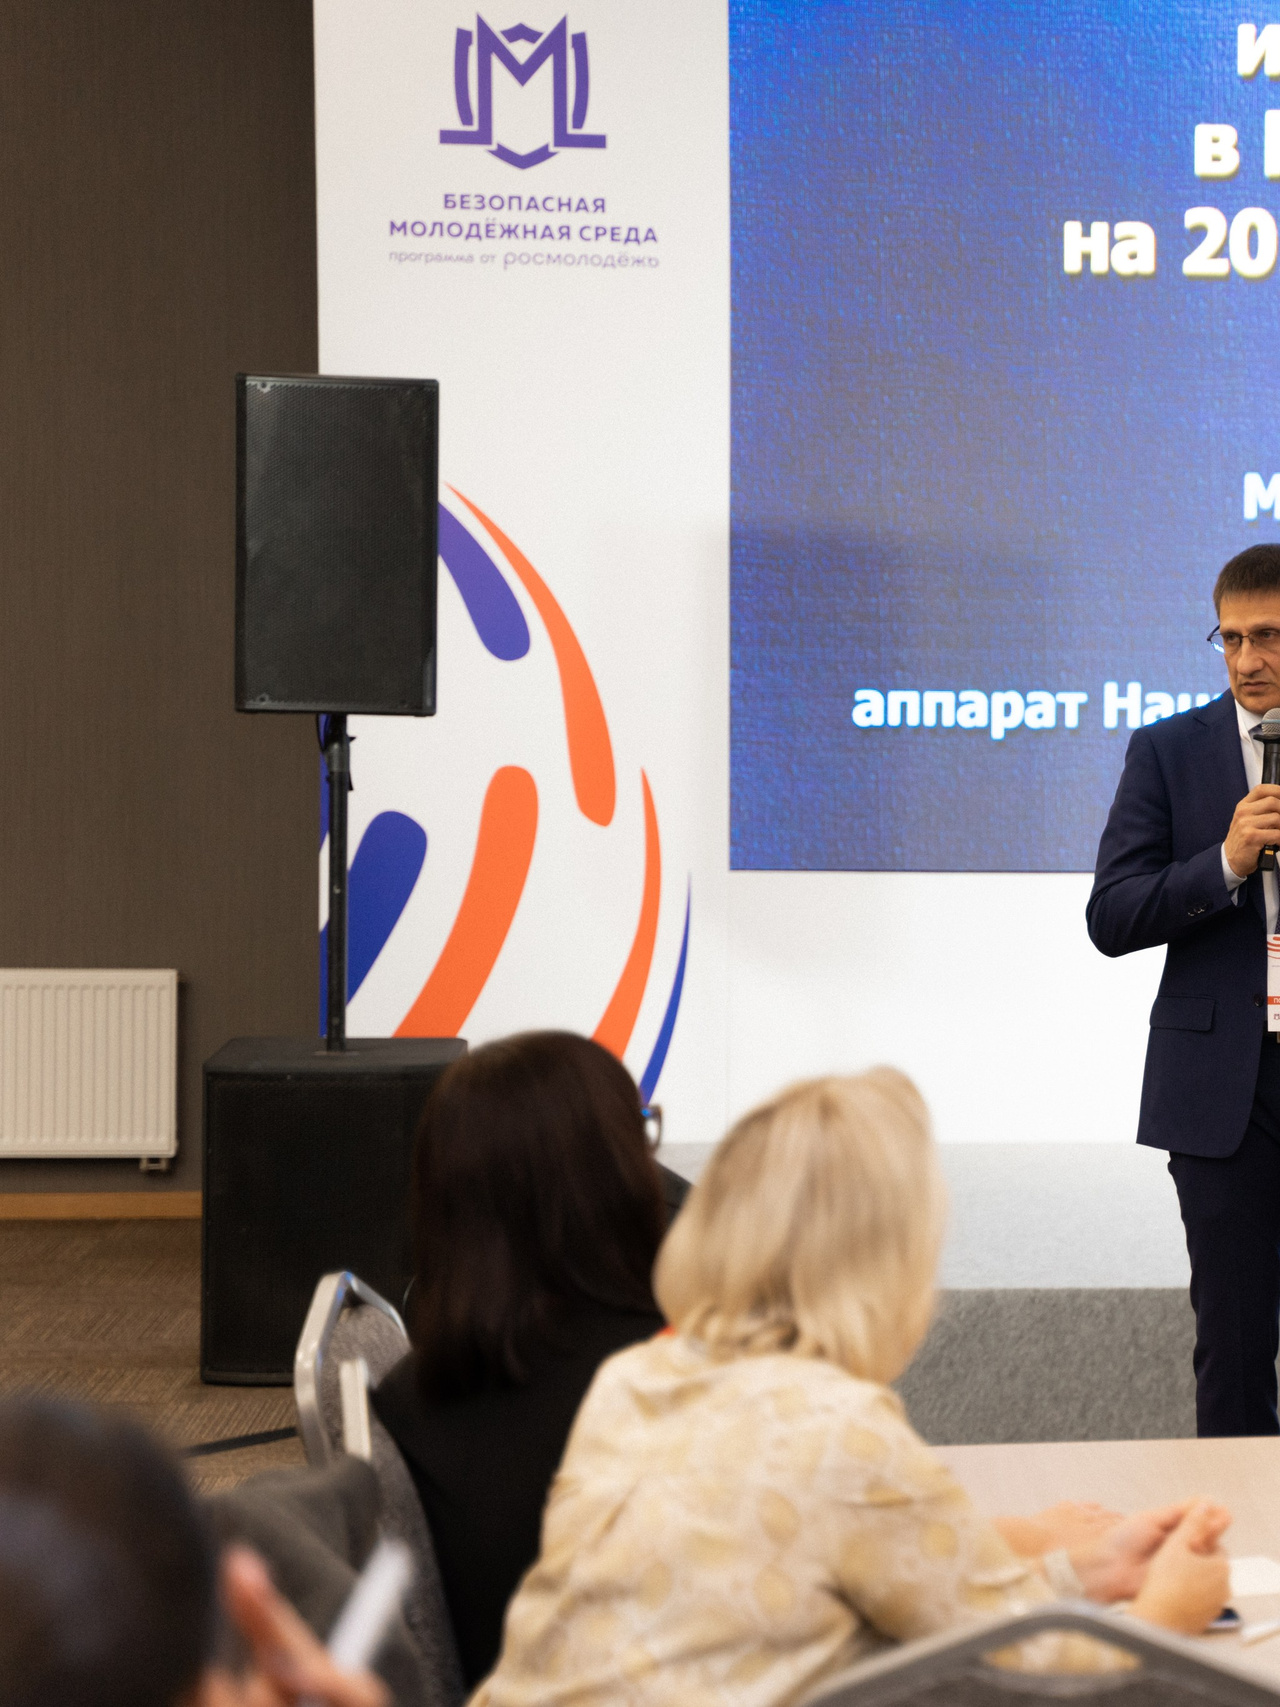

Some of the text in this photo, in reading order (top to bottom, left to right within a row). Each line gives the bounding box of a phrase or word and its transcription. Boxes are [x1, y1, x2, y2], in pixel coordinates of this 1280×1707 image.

[1194, 123, 1240, 178] в
[443, 193, 607, 214] БЕЗОПАСНАЯ
[389, 217, 659, 245] МОЛОДЁЖНАЯ СРЕДА
[1063, 220, 1157, 276] на
[388, 251, 660, 269] программа от росмолодёжь
[851, 688, 1088, 740] аппарат
